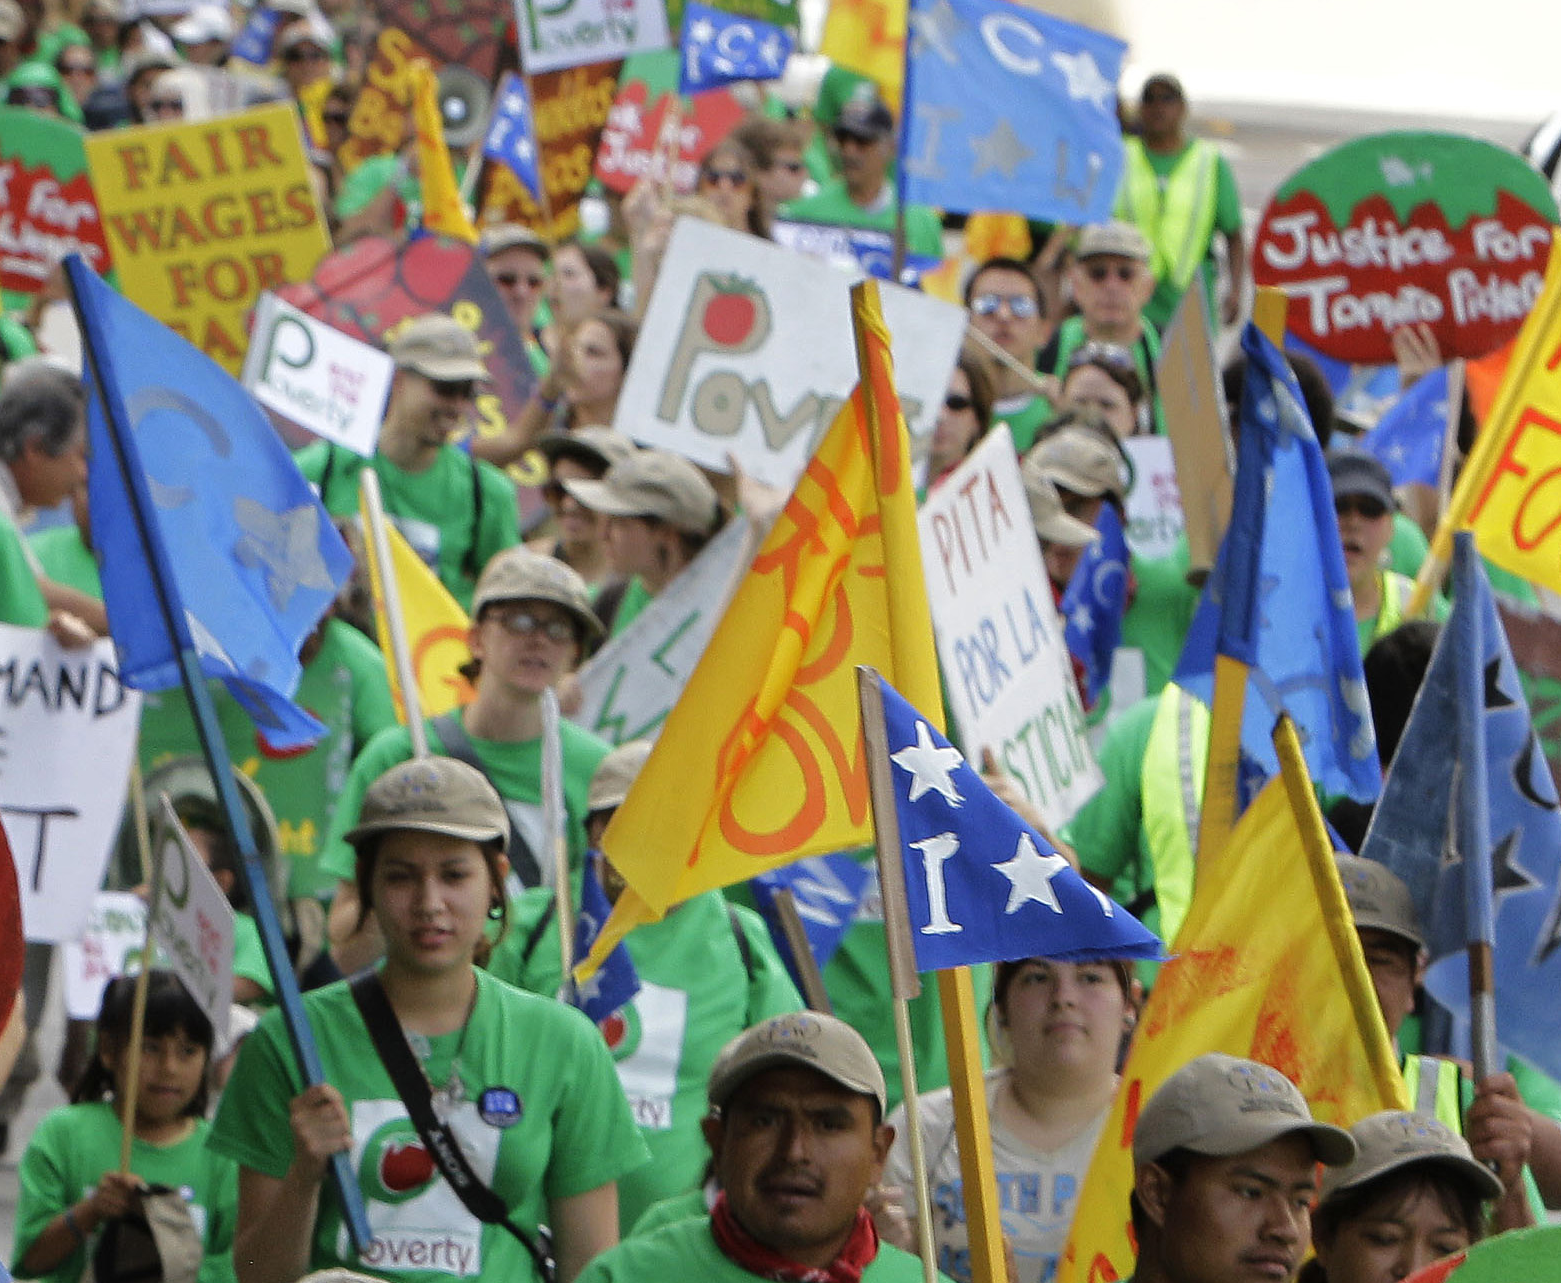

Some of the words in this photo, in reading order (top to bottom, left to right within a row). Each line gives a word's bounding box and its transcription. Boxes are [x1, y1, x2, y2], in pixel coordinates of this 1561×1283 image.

[117, 125, 283, 190] FAIR
[111, 185, 317, 255] WAGES
[168, 252, 288, 307] FOR
[931, 468, 1014, 597] PITA
[952, 617, 1015, 718] POR
[1003, 586, 1051, 664] LA
